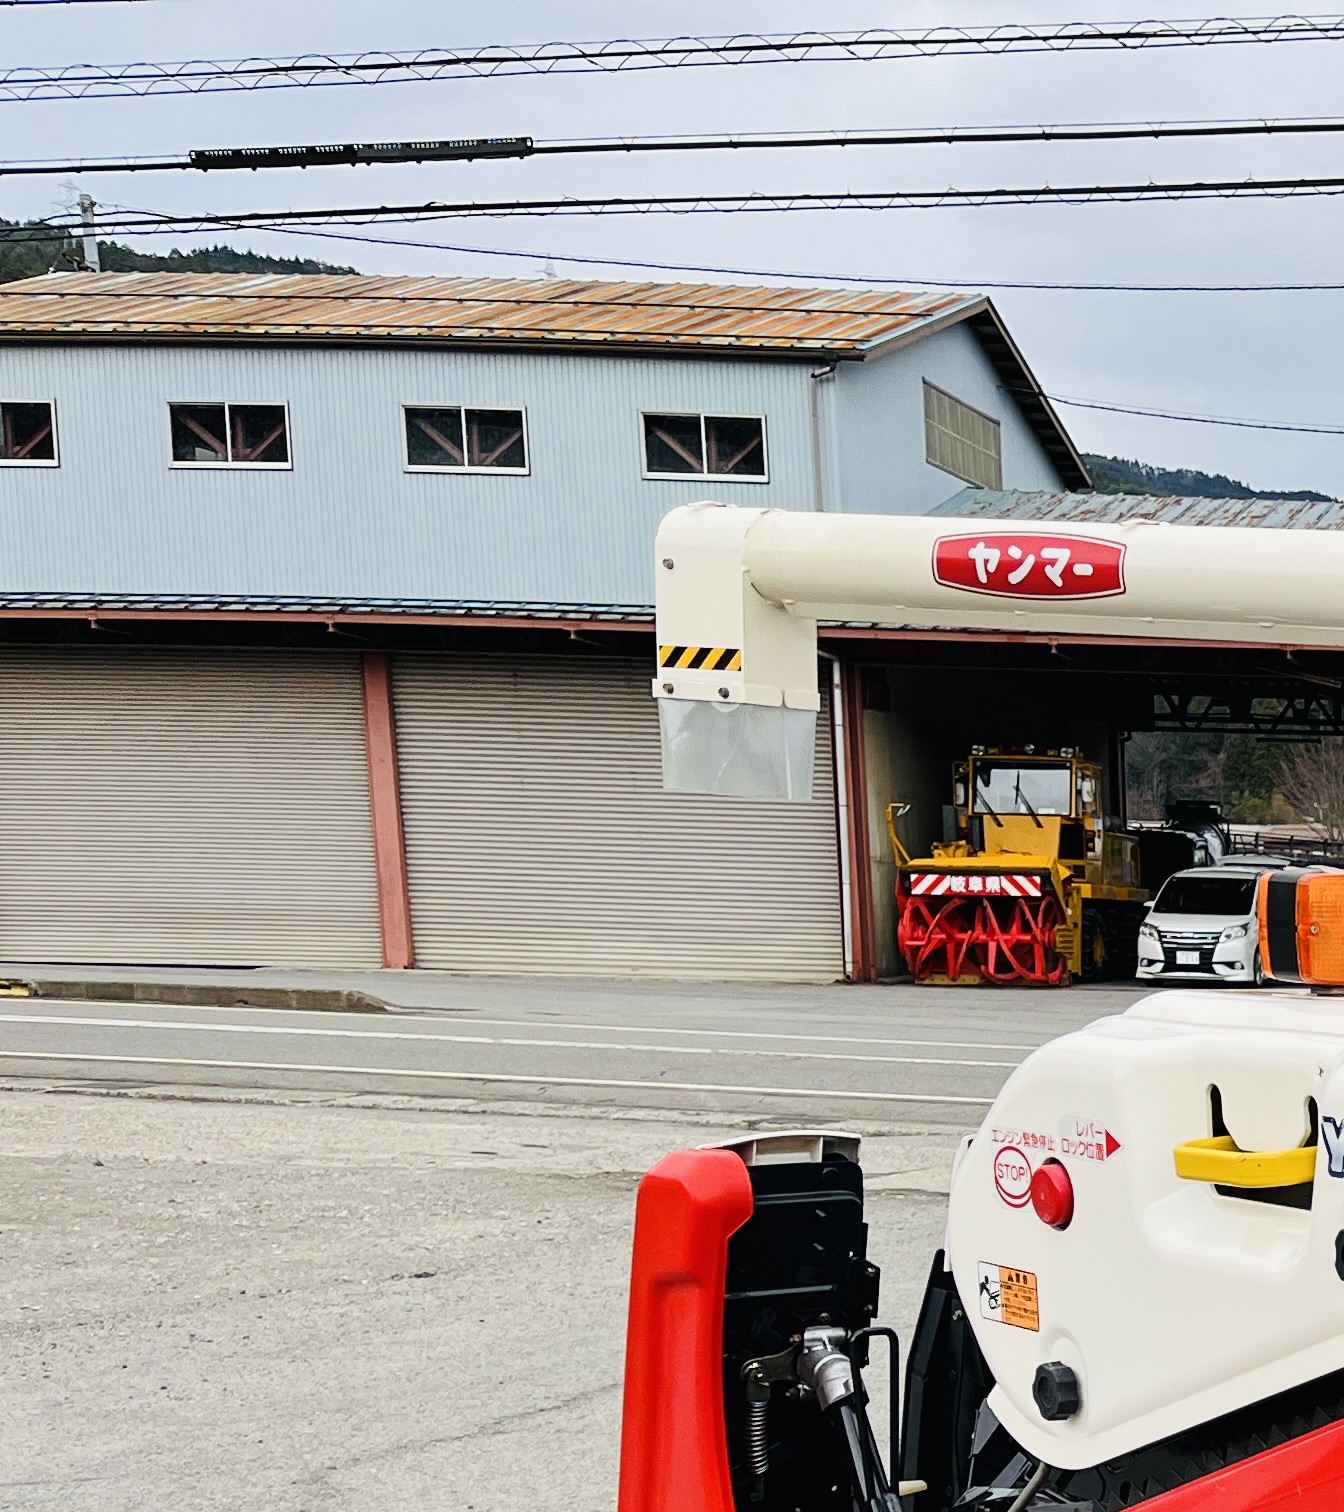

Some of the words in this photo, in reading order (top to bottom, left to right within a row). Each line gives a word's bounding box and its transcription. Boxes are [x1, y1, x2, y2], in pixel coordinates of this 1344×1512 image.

[967, 540, 1094, 588] ヤンマー
[950, 875, 1001, 893] 岐阜県
[991, 1128, 1056, 1152] エンジン緊急停止
[1075, 1120, 1104, 1140] レバー
[1060, 1137, 1106, 1162] ロック位置
[996, 1162, 1029, 1184] STOP!
